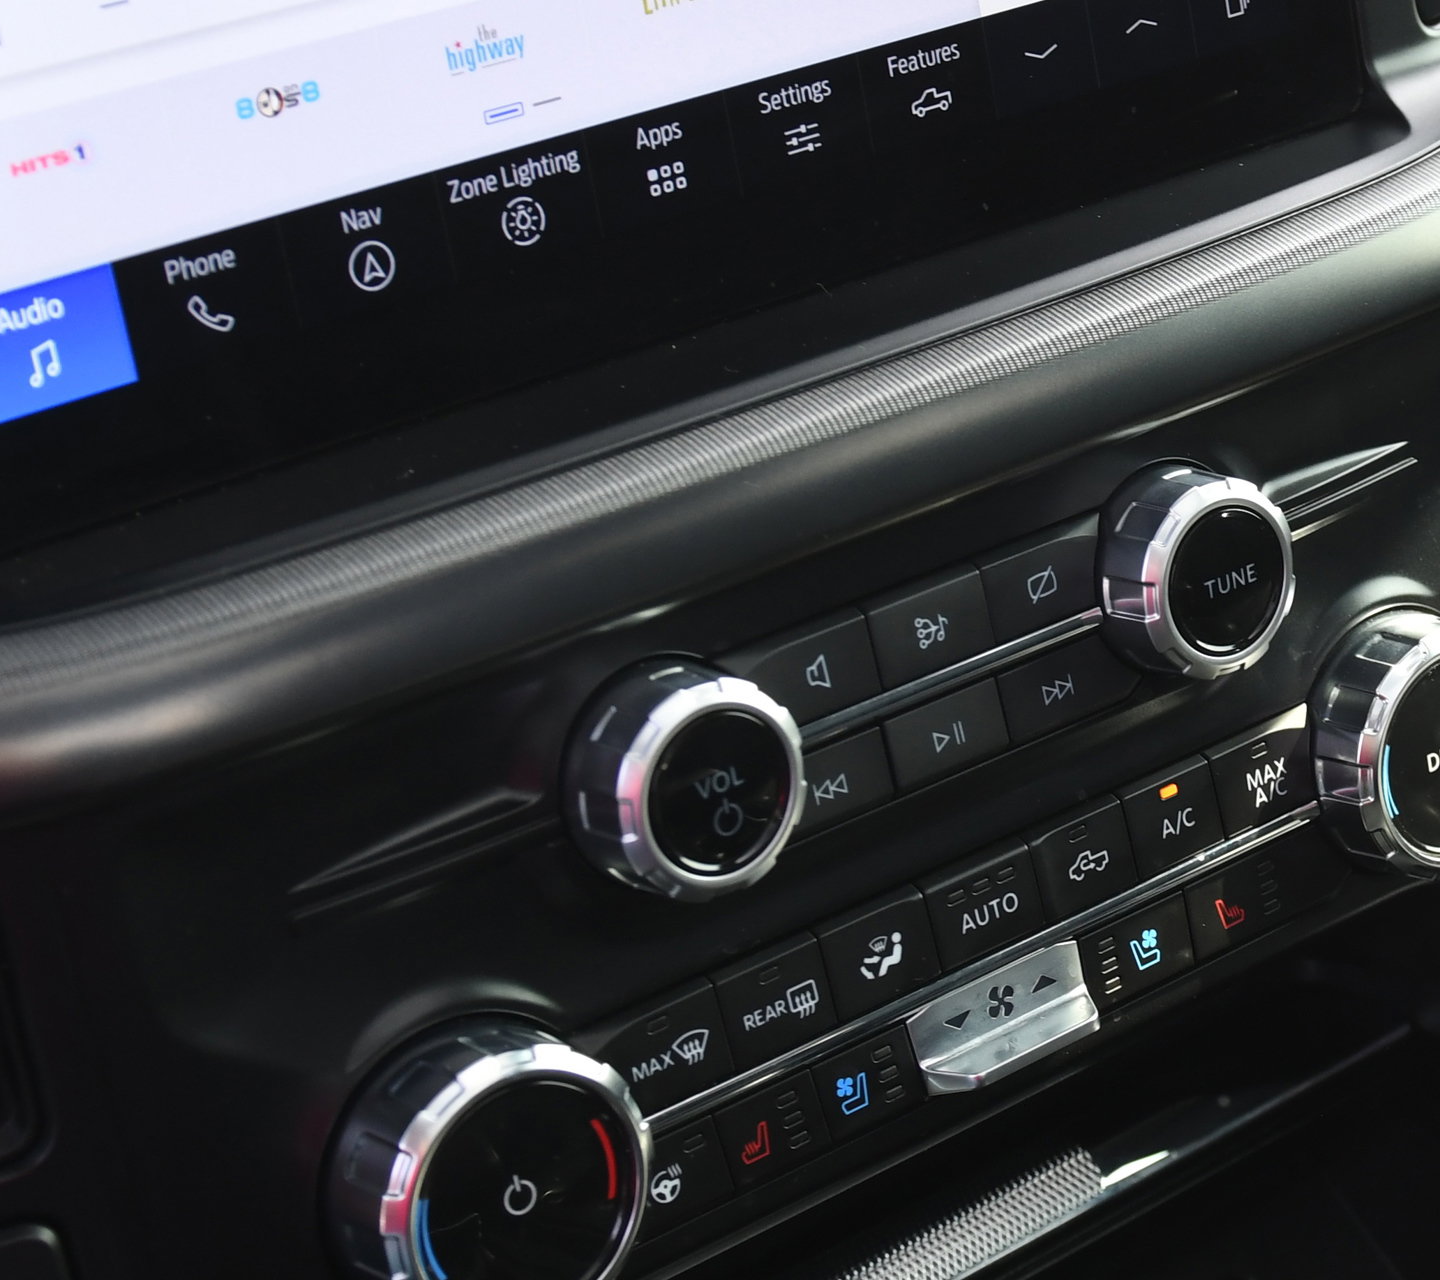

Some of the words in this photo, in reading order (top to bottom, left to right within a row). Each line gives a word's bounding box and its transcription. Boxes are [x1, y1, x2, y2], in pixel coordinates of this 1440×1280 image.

[476, 23, 498, 42] the
[444, 33, 525, 72] highway
[886, 39, 961, 78] Features
[758, 76, 832, 116] Settings
[634, 119, 683, 151] Apps
[8, 148, 70, 178] HITS
[445, 175, 498, 205] Zone
[499, 147, 581, 189] Lighting
[339, 205, 383, 234] Nav
[162, 246, 237, 285] Phone
[1204, 562, 1258, 600] TUNE
[694, 766, 744, 799] VOL
[1246, 757, 1287, 792] MAX
[1254, 775, 1288, 808] A/C
[1161, 806, 1197, 841] A/C
[961, 892, 1019, 935] AUTO
[743, 999, 787, 1031] REAR
[632, 1050, 676, 1083] MAX
